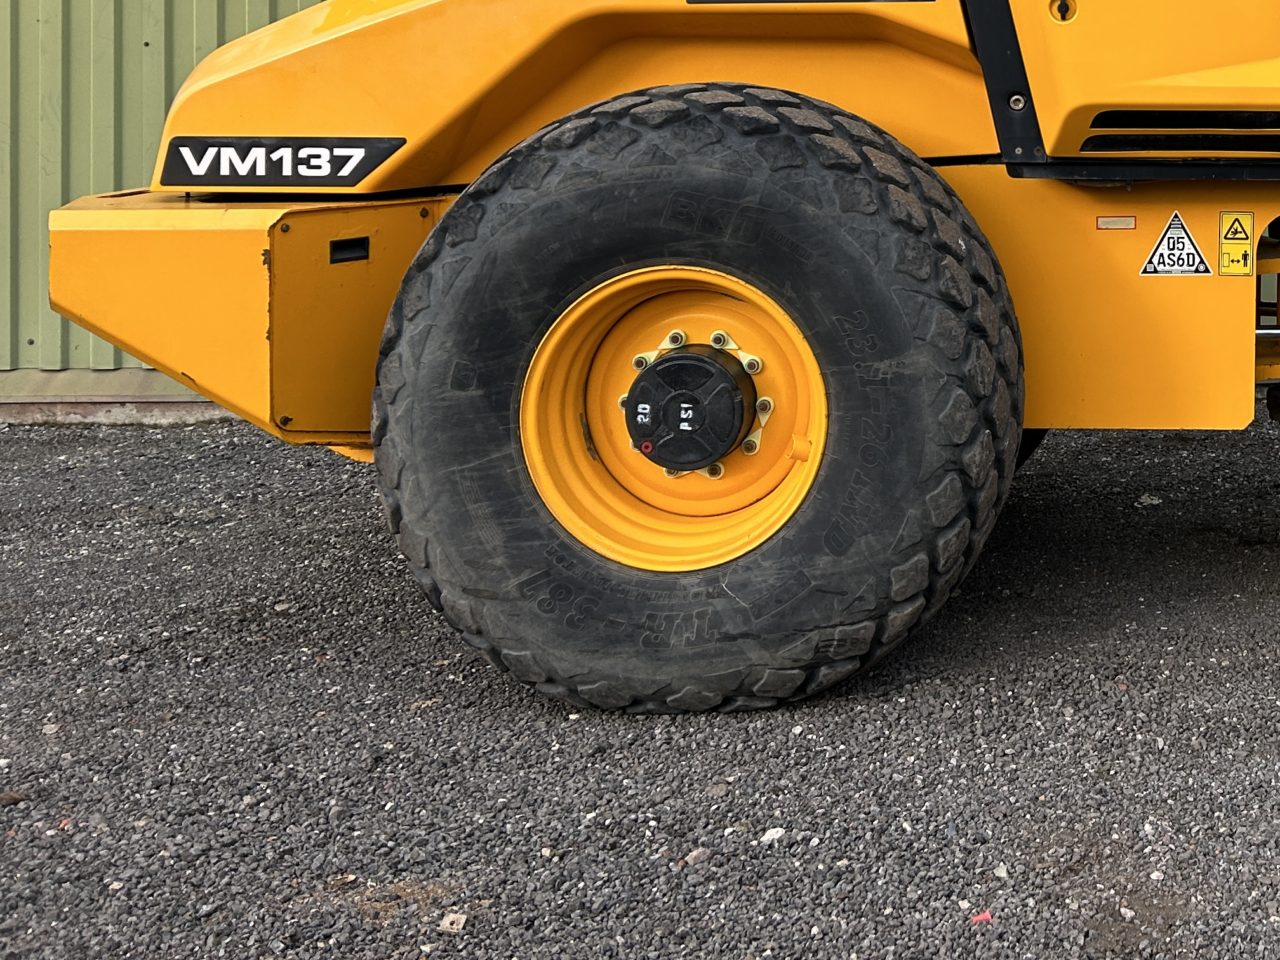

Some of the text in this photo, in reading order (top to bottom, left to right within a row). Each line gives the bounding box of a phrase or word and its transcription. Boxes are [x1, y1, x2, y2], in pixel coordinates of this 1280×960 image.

[179, 147, 365, 176] VM137
[637, 403, 650, 424] 20
[680, 403, 693, 431] PSI
